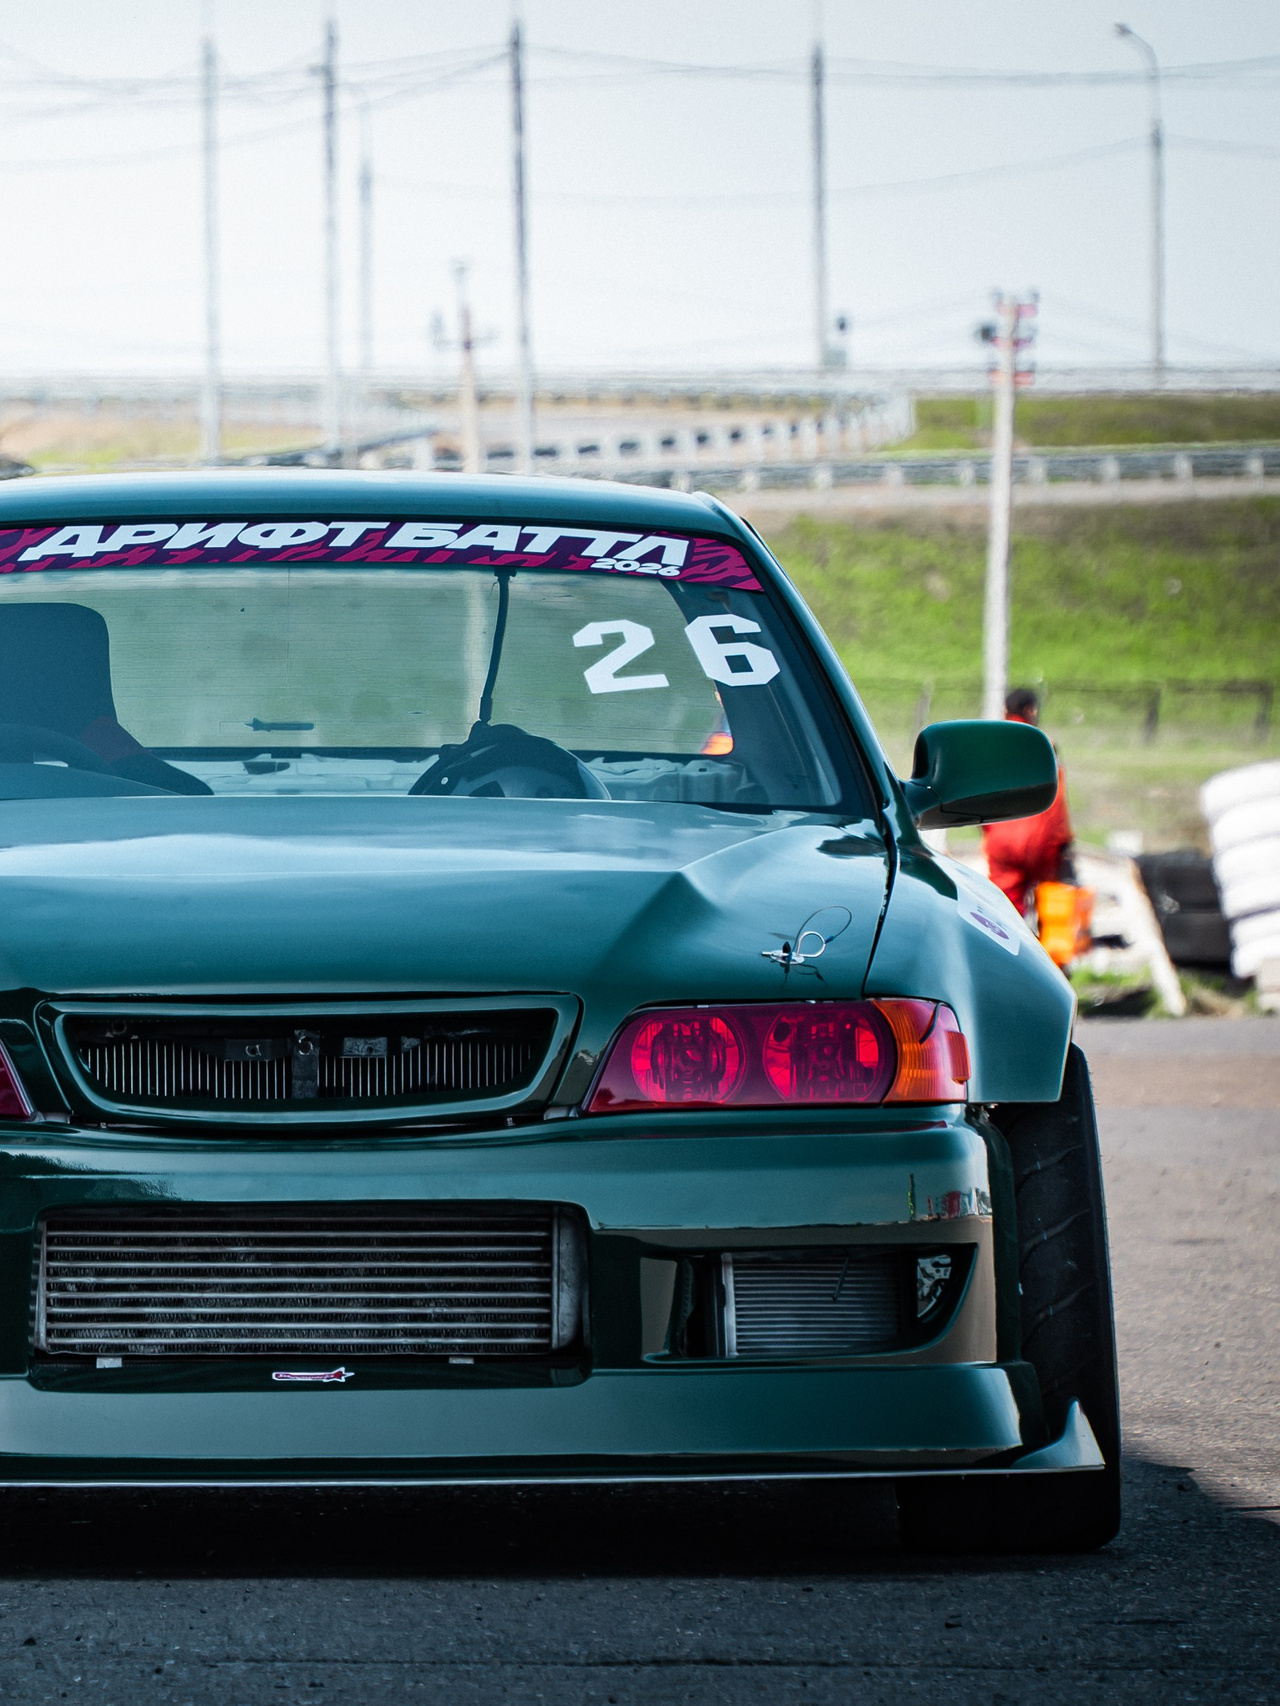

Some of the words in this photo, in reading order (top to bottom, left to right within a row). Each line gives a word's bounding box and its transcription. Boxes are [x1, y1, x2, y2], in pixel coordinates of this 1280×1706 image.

[17, 521, 390, 562] ДРИФТ
[384, 522, 688, 567] БАТТЛ
[590, 557, 681, 576] 2026
[572, 613, 781, 694] 26
